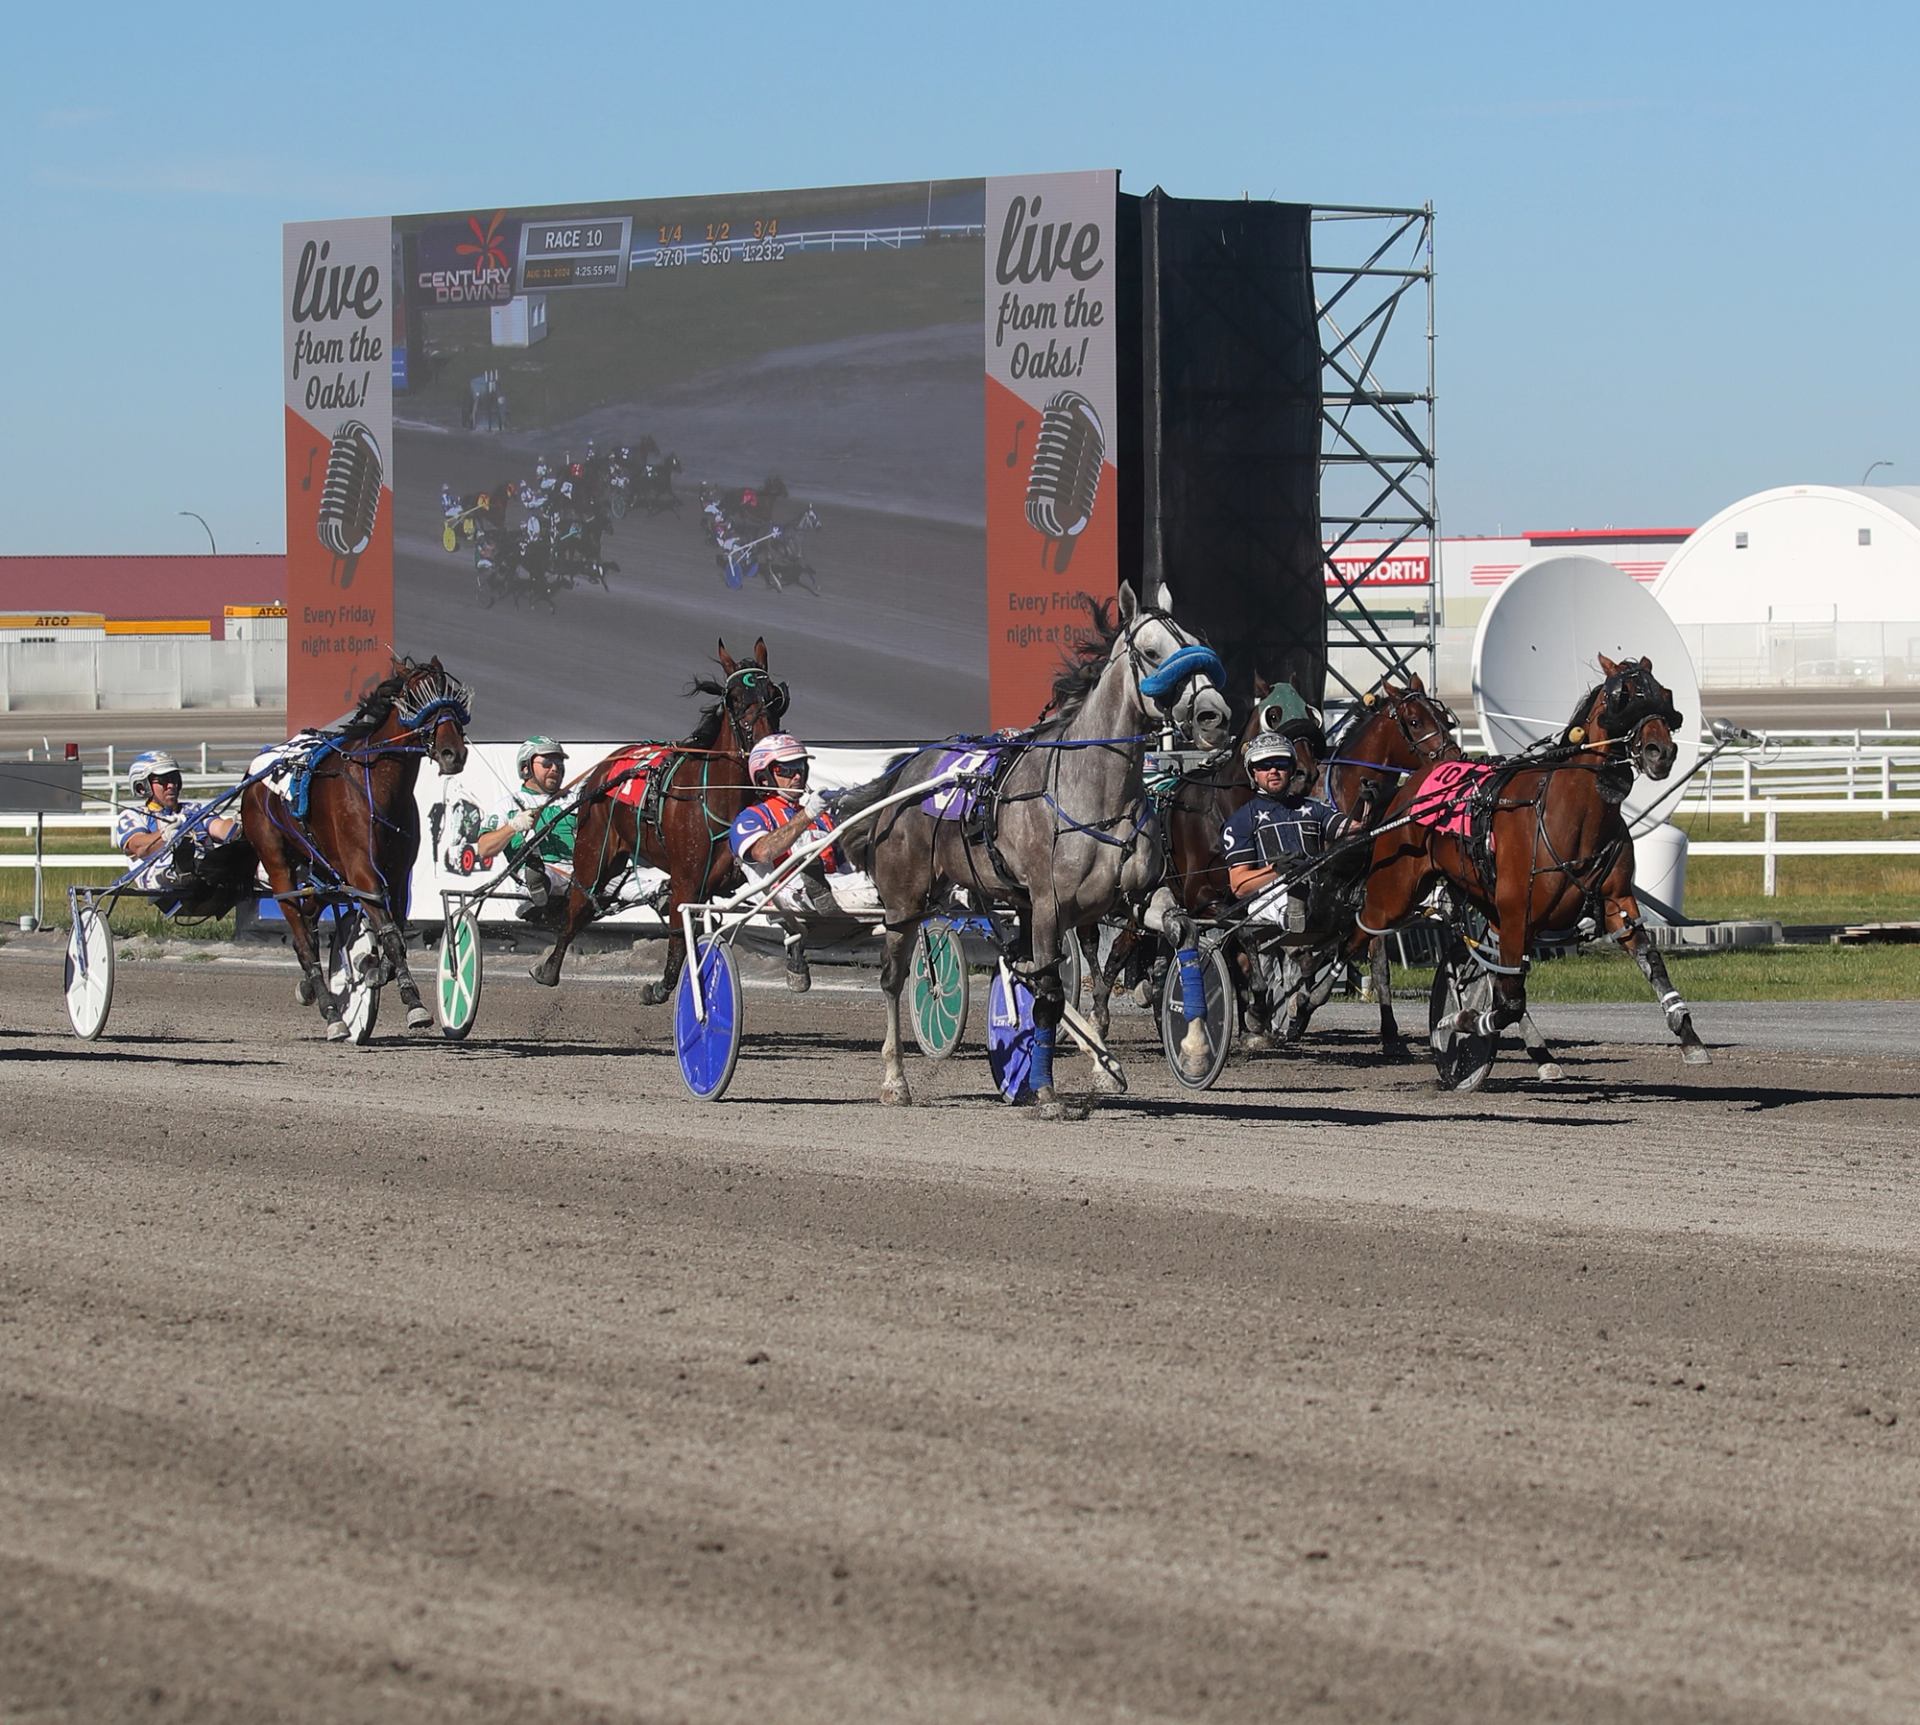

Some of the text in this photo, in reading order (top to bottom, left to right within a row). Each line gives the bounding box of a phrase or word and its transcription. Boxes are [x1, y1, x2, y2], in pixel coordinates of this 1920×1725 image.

[545, 229, 603, 249] RACE 10
[659, 224, 683, 246] 1/4
[706, 222, 731, 245] 1/2
[753, 219, 778, 241] 3/4
[996, 195, 1104, 285] live
[655, 249, 683, 267] 27:0
[701, 246, 731, 264] 56:0
[292, 239, 384, 324] live
[419, 268, 512, 288] CENTURY
[575, 264, 617, 277] 4:25:55 PM
[436, 283, 510, 303] DOWNS
[997, 287, 1105, 347] from the
[293, 326, 383, 380] from the
[1010, 336, 1090, 380] Oaks!
[305, 371, 371, 410] Oaks!
[1323, 560, 1425, 583] KENWORTH
[258, 607, 288, 616] ATCO
[1008, 593, 1049, 615] Every
[34, 616, 70, 627] ATCO
[304, 606, 376, 628] Every Friday
[301, 636, 379, 657] night at 8pm!
[1007, 624, 1043, 648] night
[1046, 626, 1060, 643] at
[1434, 765, 1462, 785] 10
[118, 809, 135, 834] G
[488, 815, 499, 828] G
[1223, 827, 1235, 850] S
